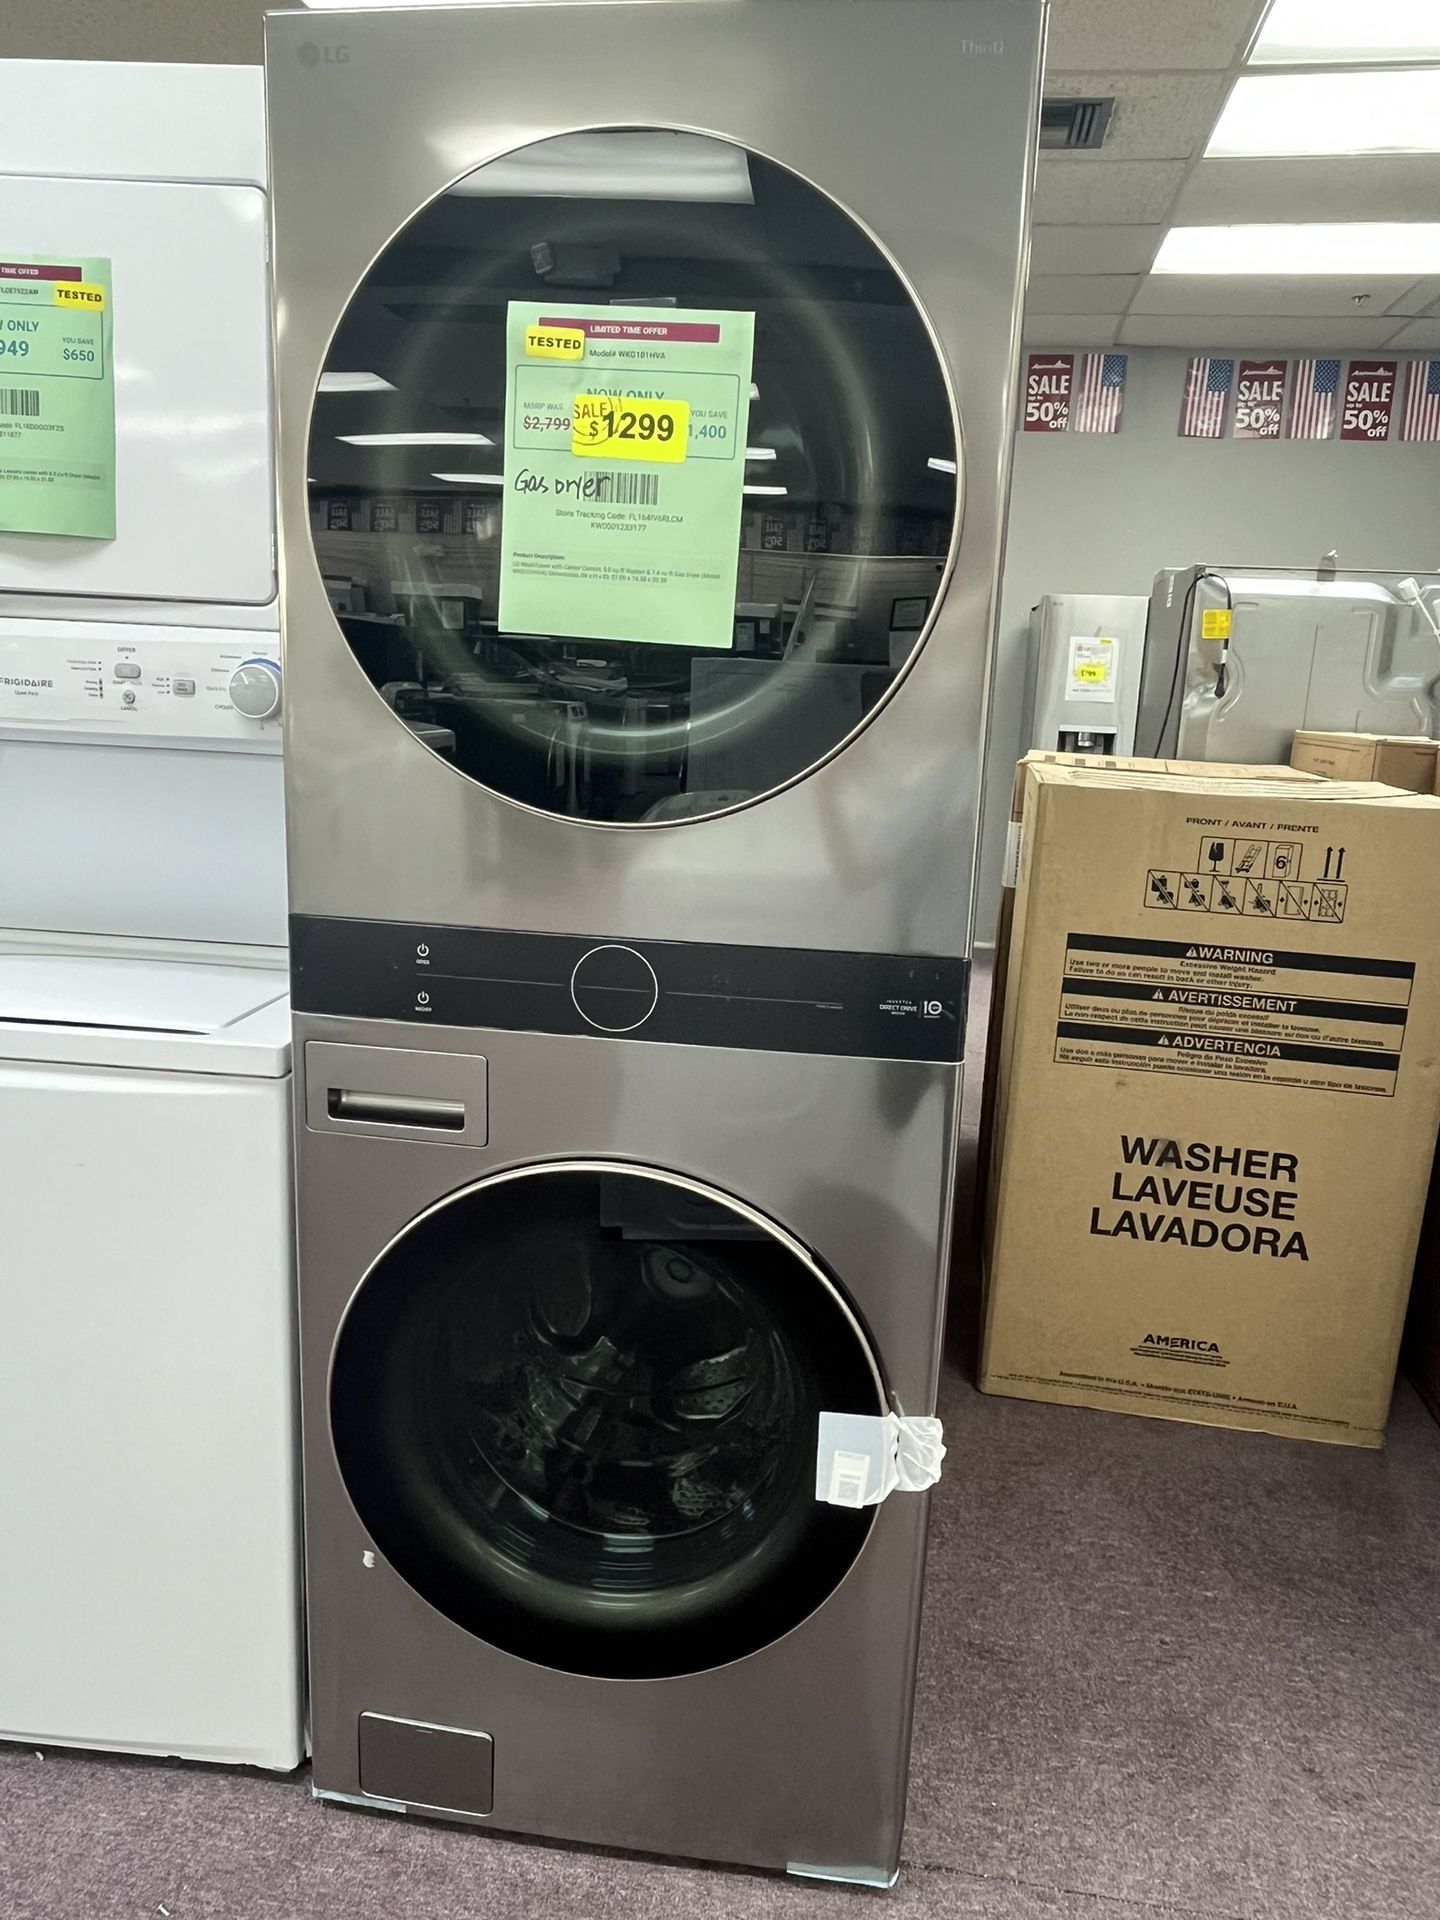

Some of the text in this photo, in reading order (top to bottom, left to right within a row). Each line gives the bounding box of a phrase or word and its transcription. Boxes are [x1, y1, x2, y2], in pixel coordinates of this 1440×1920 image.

[57, 289, 102, 303] TESTED
[7, 320, 39, 333] ONLY
[590, 325, 668, 336] LIMITED TIME OFFER
[62, 336, 95, 346] YOU SAVE
[528, 335, 582, 350] TESTED
[62, 348, 95, 362] $650
[589, 349, 617, 359] Model#
[1028, 375, 1070, 395] SALE
[1238, 381, 1283, 401] SALE
[1347, 381, 1392, 402] SALE
[523, 402, 565, 412] MSRP WAS
[574, 402, 607, 420] SALE
[690, 410, 728, 420] YOU SAVE
[1026, 401, 1069, 422] 50%
[523, 416, 571, 434] $2,799
[1049, 417, 1068, 429] off
[1235, 407, 1280, 429] 50%
[1343, 409, 1388, 430] 50%
[1259, 423, 1279, 435] off
[1367, 426, 1387, 437] off
[514, 468, 549, 494] Gas
[556, 509, 575, 518] Store
[576, 510, 606, 521] Tracking
[1186, 817, 1222, 827] FRONT
[1231, 821, 1267, 831] AVANT
[1277, 824, 1319, 833] FRENTE
[1198, 946, 1274, 964] WARNING
[1168, 989, 1298, 1012] AVERTISSEMENT
[1172, 1034, 1281, 1056] ADVERTENCIA
[1121, 1135, 1298, 1183] WASHER
[1112, 1172, 1298, 1221] LAVEUSE
[1090, 1207, 1309, 1261] LAVADORA
[1143, 1334, 1219, 1353] AMERICA
